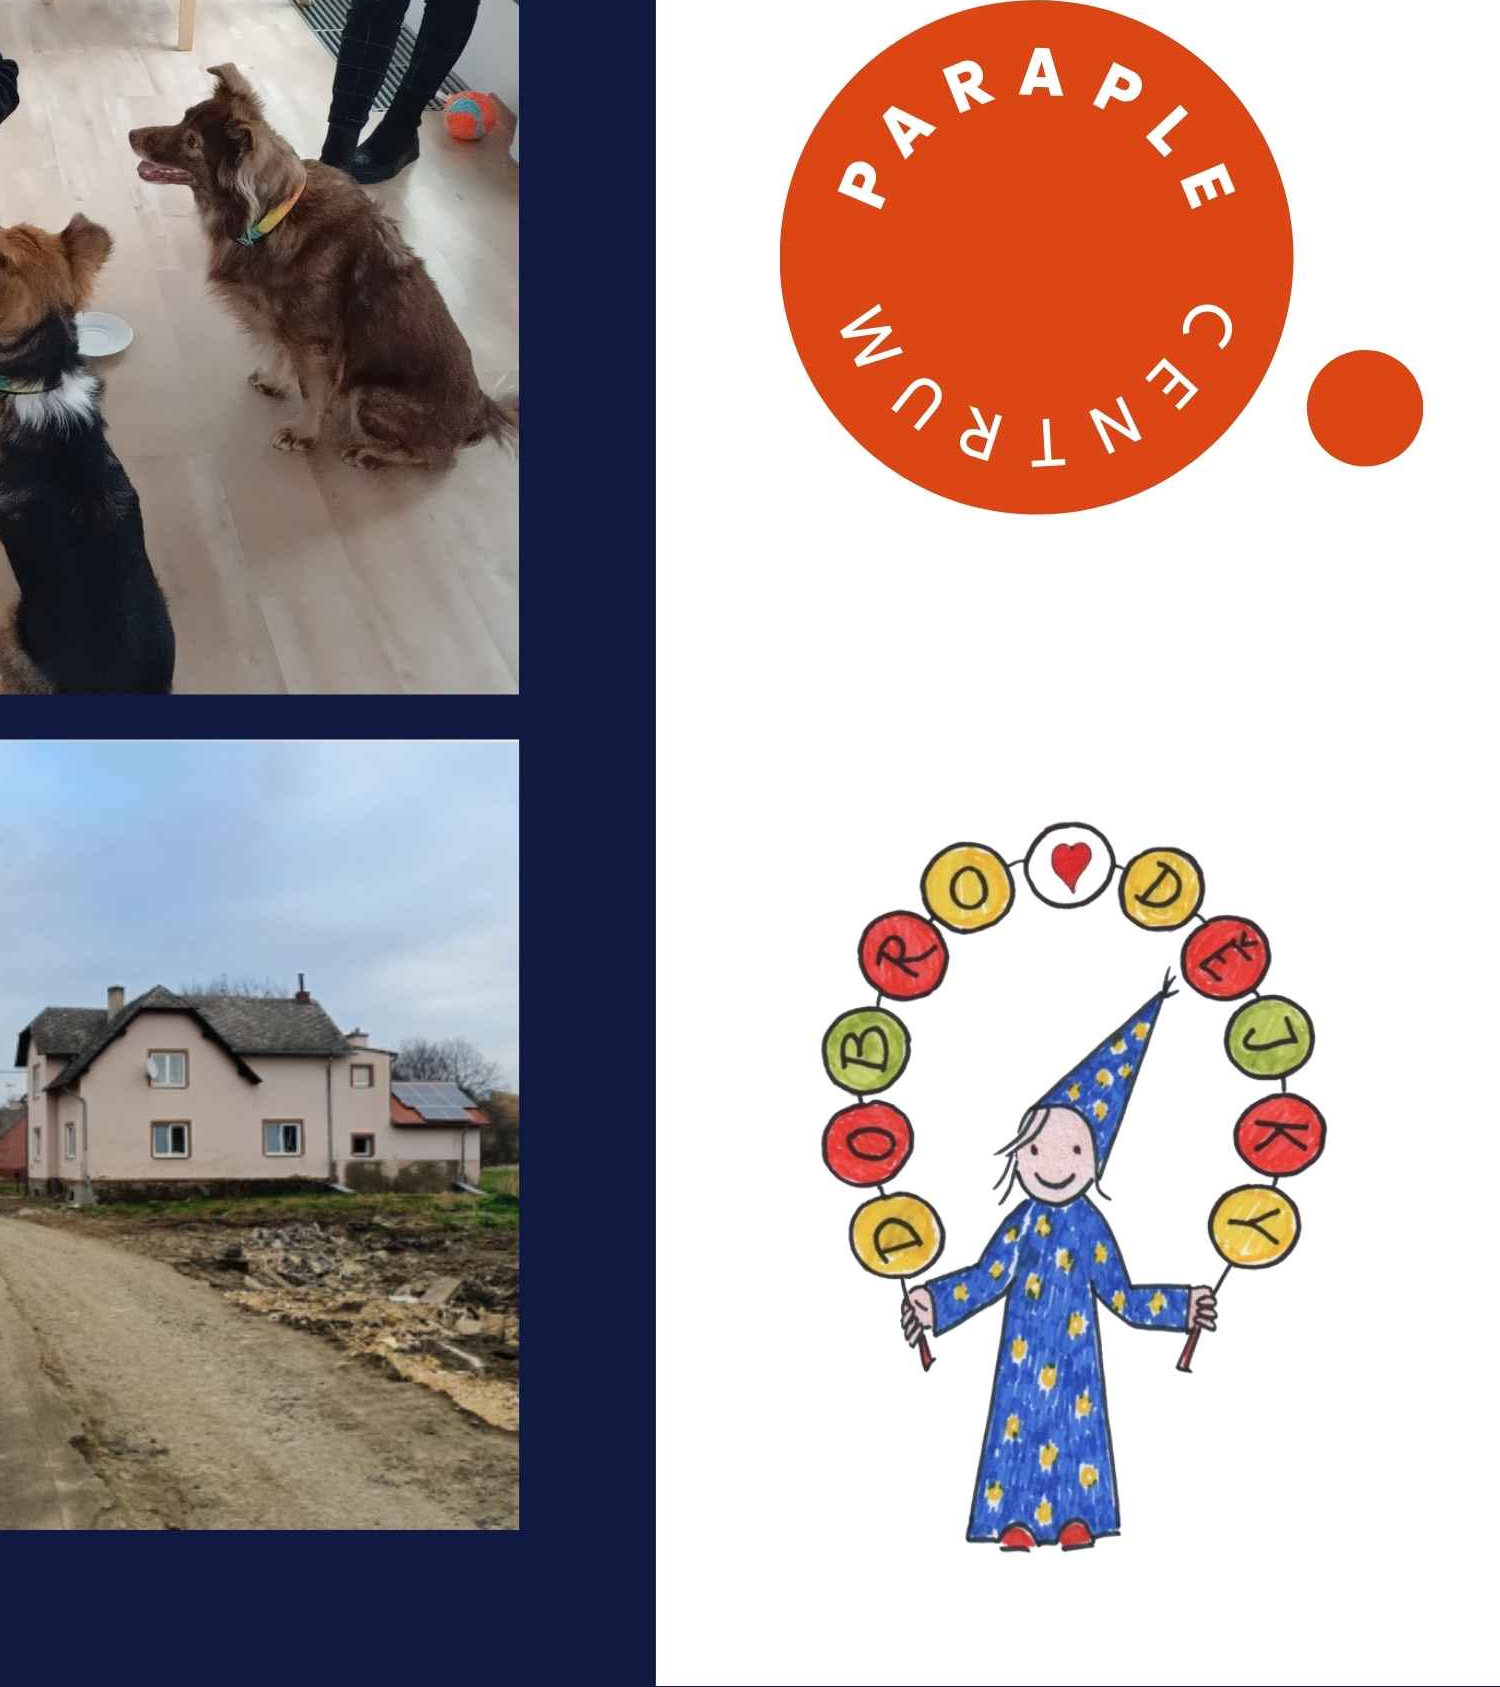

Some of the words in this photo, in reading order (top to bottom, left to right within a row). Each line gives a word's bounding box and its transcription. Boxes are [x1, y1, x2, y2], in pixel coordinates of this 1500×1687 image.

[838, 47, 1236, 209] PARAPLE
[840, 303, 1234, 468] CENTRUM
[840, 865, 991, 1263] DOBRO
